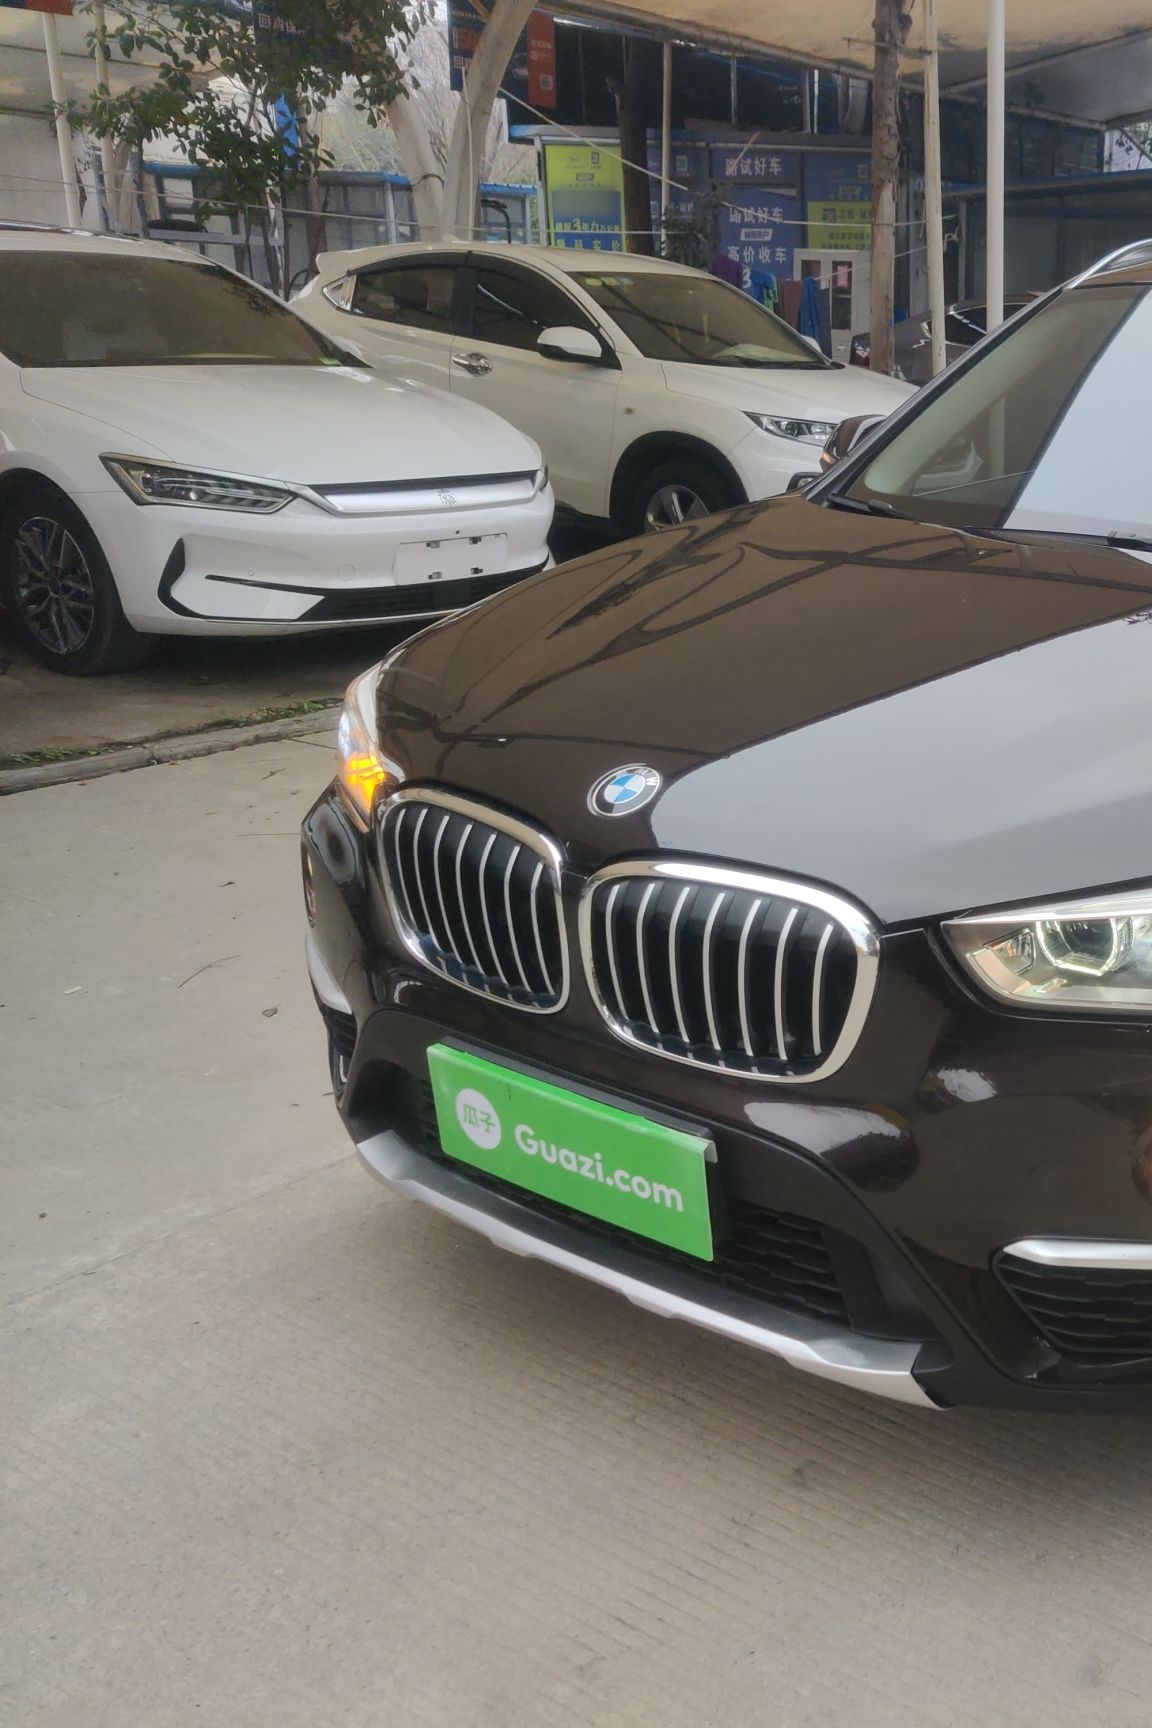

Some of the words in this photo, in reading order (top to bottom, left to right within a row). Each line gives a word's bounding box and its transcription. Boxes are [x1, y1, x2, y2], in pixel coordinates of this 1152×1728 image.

[728, 246, 787, 264] 高价收车
[463, 1103, 497, 1132] 瓜子
[514, 1123, 684, 1212] Guazi.com
